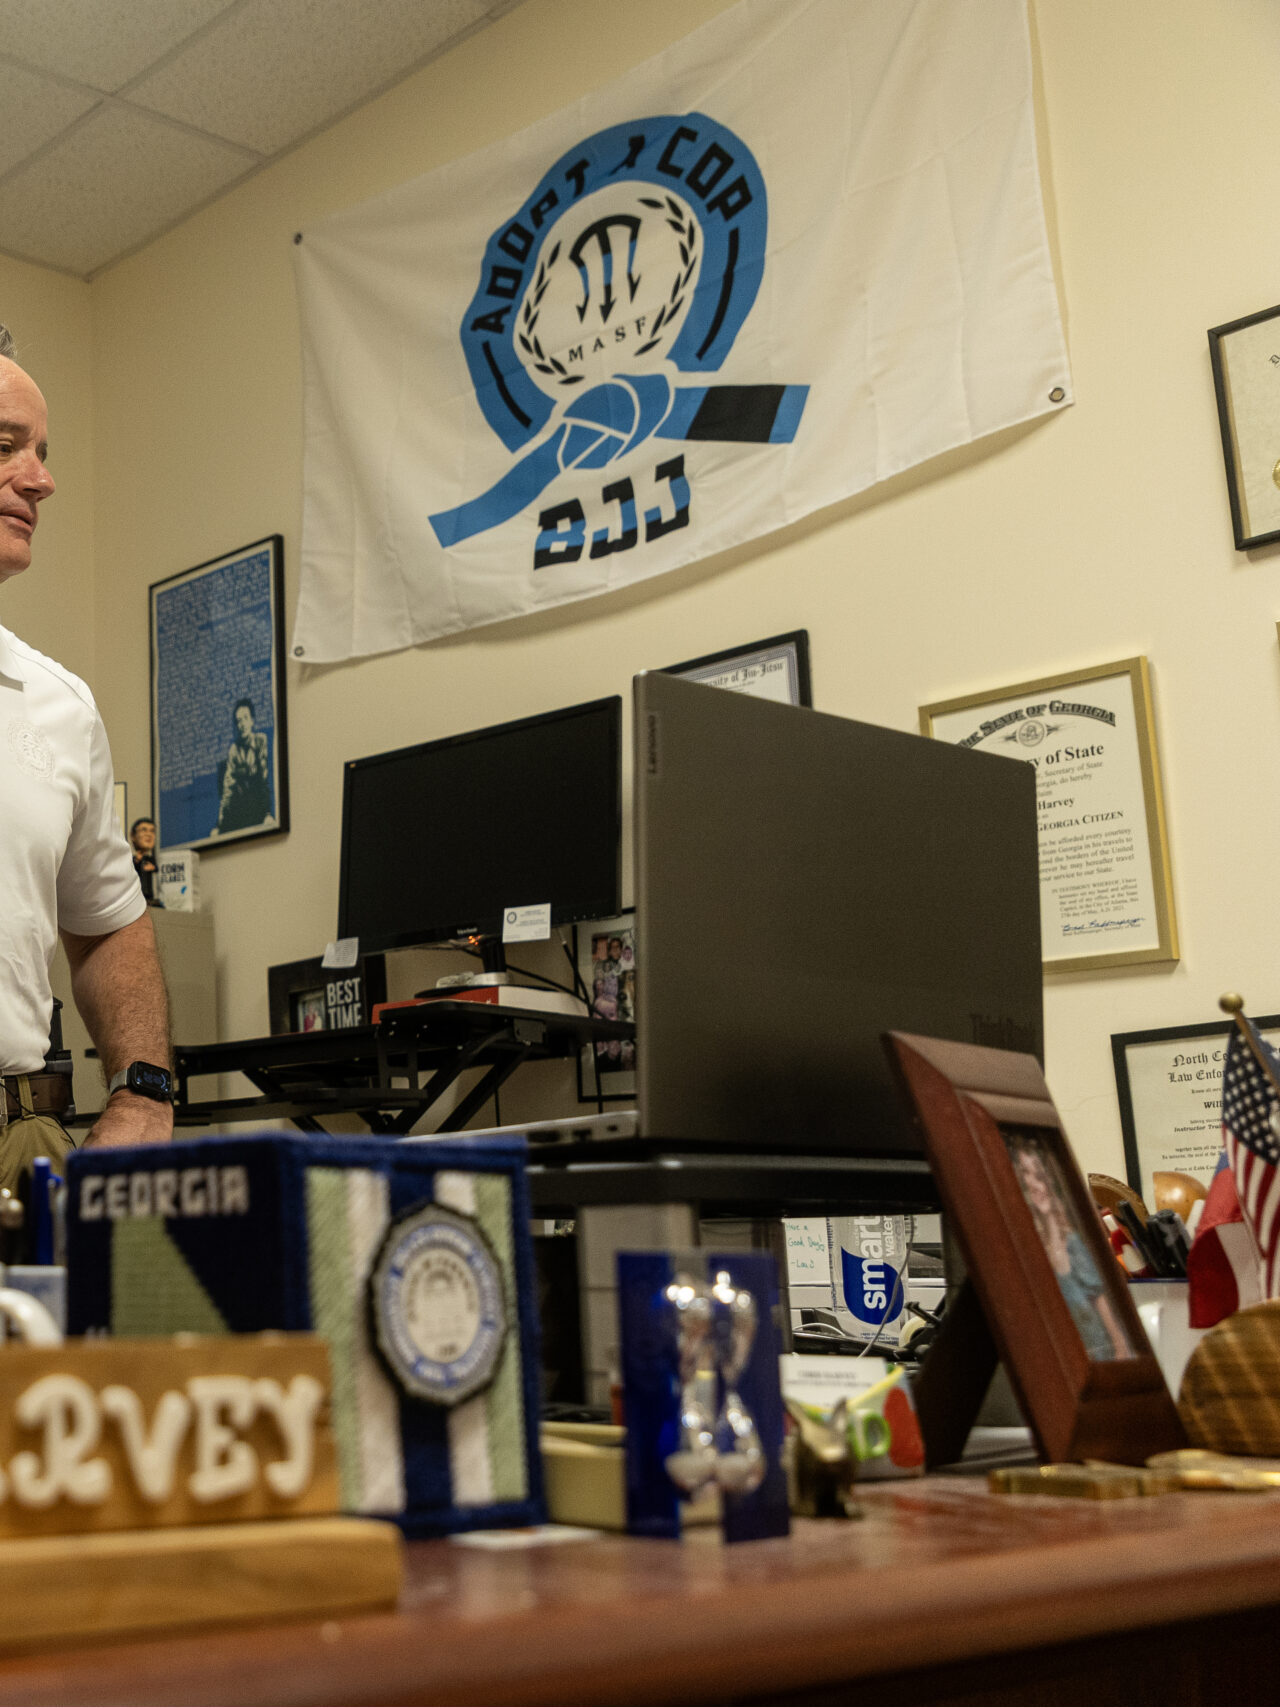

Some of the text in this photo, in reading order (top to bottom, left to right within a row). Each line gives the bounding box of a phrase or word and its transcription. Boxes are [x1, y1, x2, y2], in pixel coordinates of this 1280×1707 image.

[470, 158, 591, 334] ADOPT
[656, 126, 753, 222] COP
[568, 316, 647, 362] MASF
[534, 453, 691, 570] BJJ
[980, 710, 1024, 736] STATE
[1025, 704, 1047, 718] OF
[1049, 700, 1116, 727] GEORGIA
[1046, 750, 1064, 765] of
[1065, 743, 1104, 762] State
[1045, 767, 1074, 777] Secretary
[1038, 797, 1075, 811] Harvey
[1082, 810, 1124, 824] CITIZEN
[327, 978, 360, 1006] BEST
[328, 1002, 361, 1030] TIME
[1172, 1051, 1209, 1068] North
[1168, 1070, 1193, 1083] Law
[80, 1165, 249, 1221] GEORGIA
[854, 1216, 886, 1310] smart
